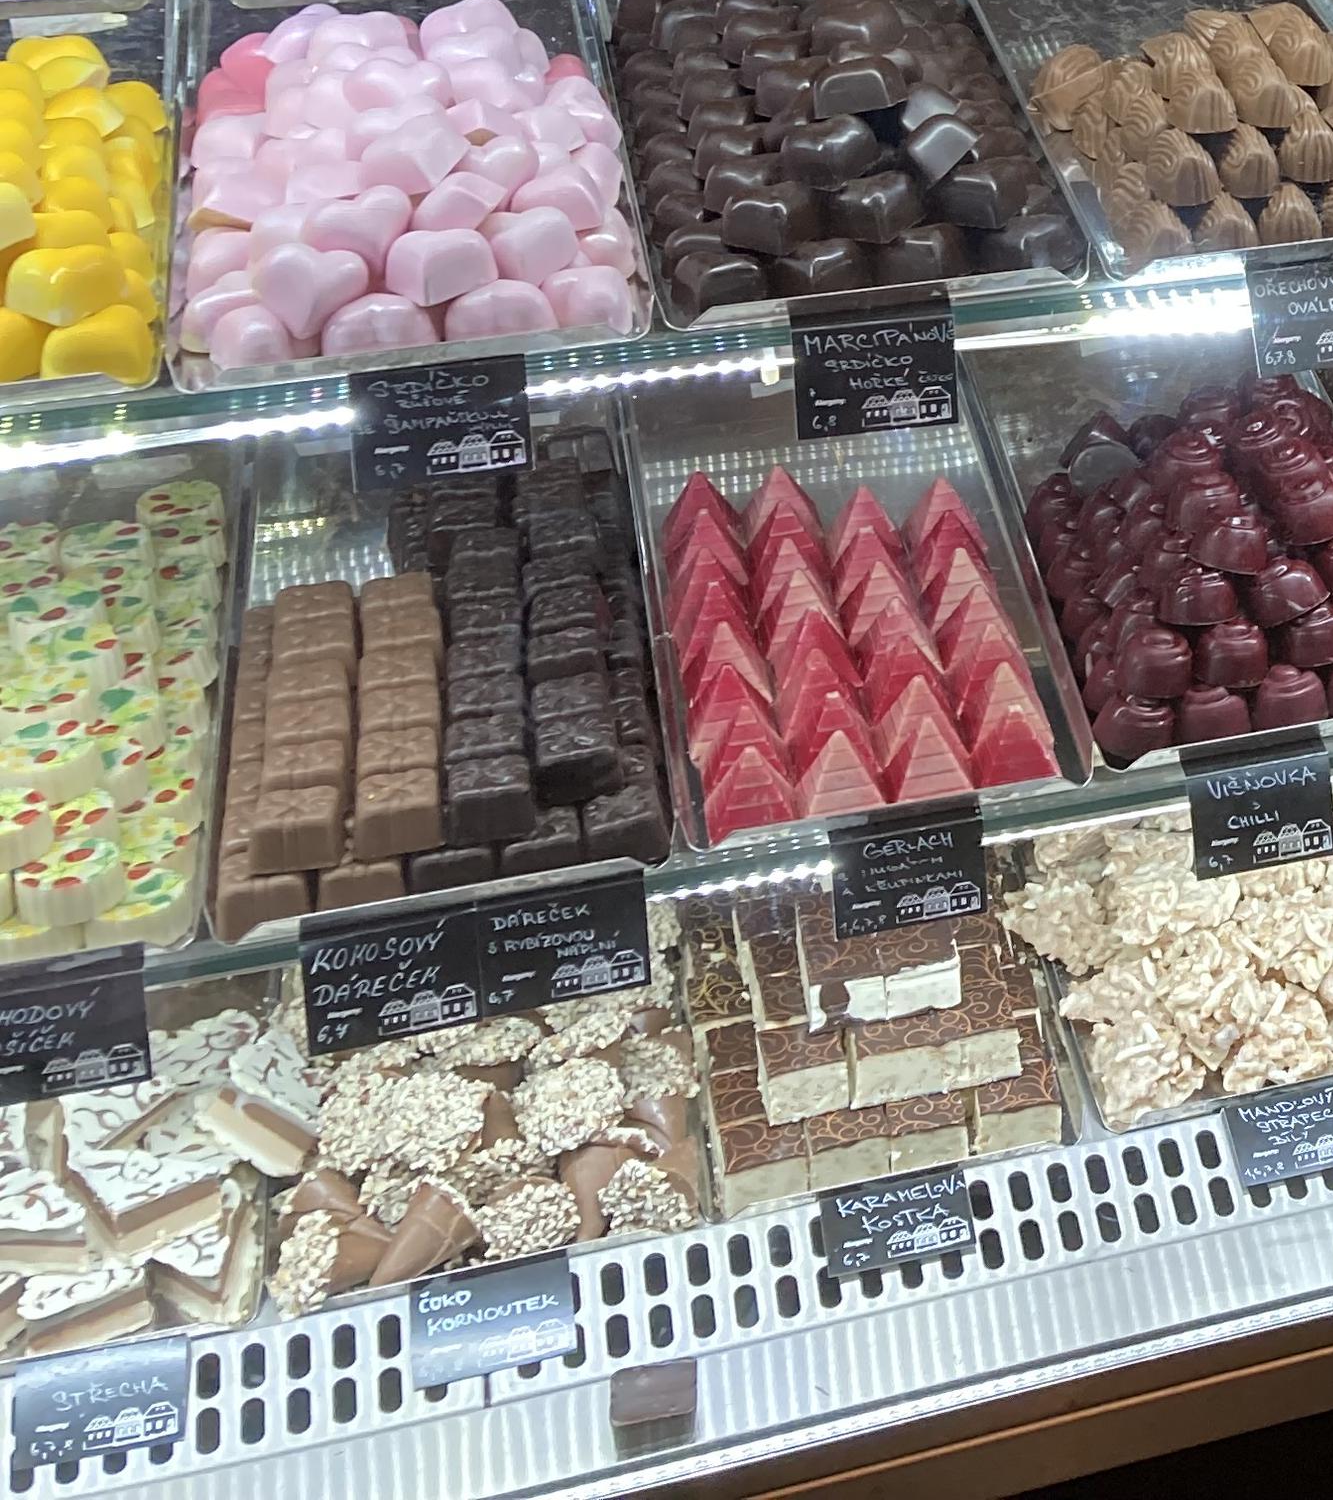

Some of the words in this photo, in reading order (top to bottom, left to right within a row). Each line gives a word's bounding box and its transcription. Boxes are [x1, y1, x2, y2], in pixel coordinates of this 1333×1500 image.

[824, 352, 914, 373] SRDÍČKO
[1265, 349, 1297, 366] 6,7,8
[367, 368, 490, 398] SRDÍČKO
[849, 368, 911, 390] HOŘKÉ
[1206, 765, 1318, 800] VIŠŇOVKA
[1226, 809, 1281, 830] CHILLI
[862, 831, 955, 860] GERLACH
[489, 901, 592, 932] DÁREČEK
[309, 917, 447, 976] KOKOSOVÝ
[503, 928, 597, 953] RYBÍZOVOU
[311, 958, 443, 1008] DÁREČEK
[0, 986, 102, 1027] HODOVÝ
[0, 1024, 77, 1057] ŠÍČEK
[1267, 1123, 1317, 1146] BÍLÝ
[835, 1171, 966, 1219] KARAMELOVÁ
[860, 1202, 951, 1236] KOSTKA
[417, 1289, 473, 1315] ČOKO
[425, 1293, 561, 1338] KORNOUTEK
[50, 1375, 170, 1412] STŘECHA
